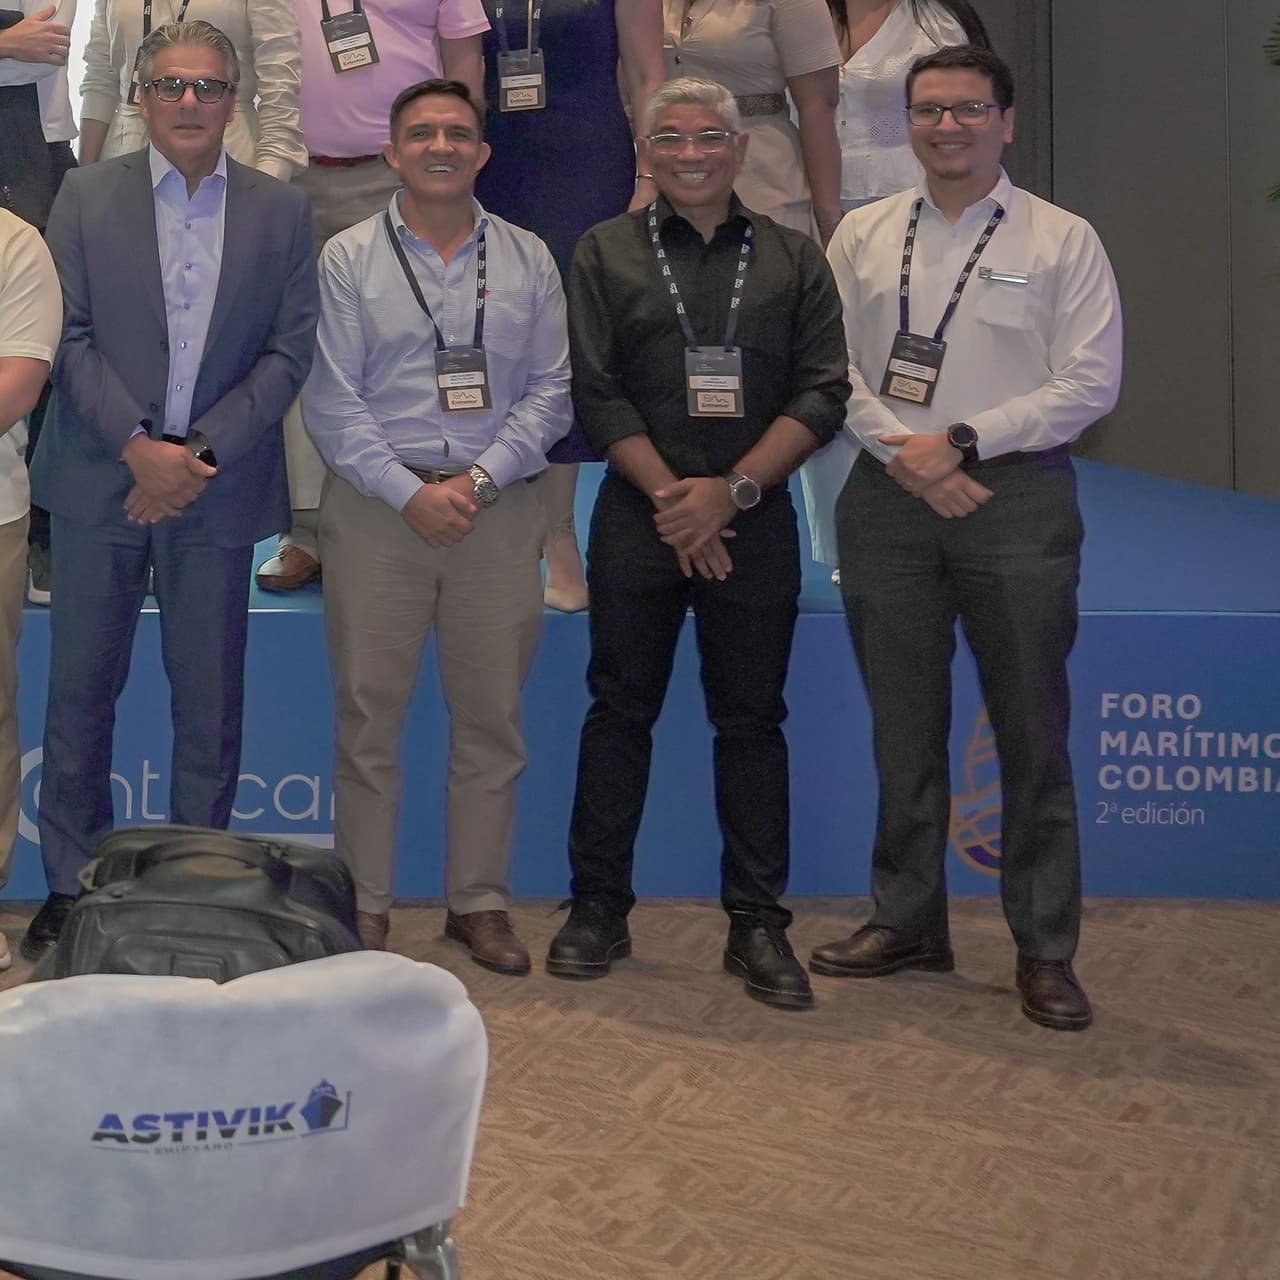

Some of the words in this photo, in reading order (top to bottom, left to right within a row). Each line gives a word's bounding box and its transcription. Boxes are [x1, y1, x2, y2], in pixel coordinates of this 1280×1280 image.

[1101, 693, 1202, 719] FORO
[1100, 725, 1280, 759] MARÍTIMO
[1098, 764, 1280, 793] COLOMBI
[1095, 801, 1118, 824] 2ª
[1121, 801, 1205, 825] edición
[91, 1101, 297, 1144] ASTIVIK
[154, 1142, 233, 1156] SHIPYARD
